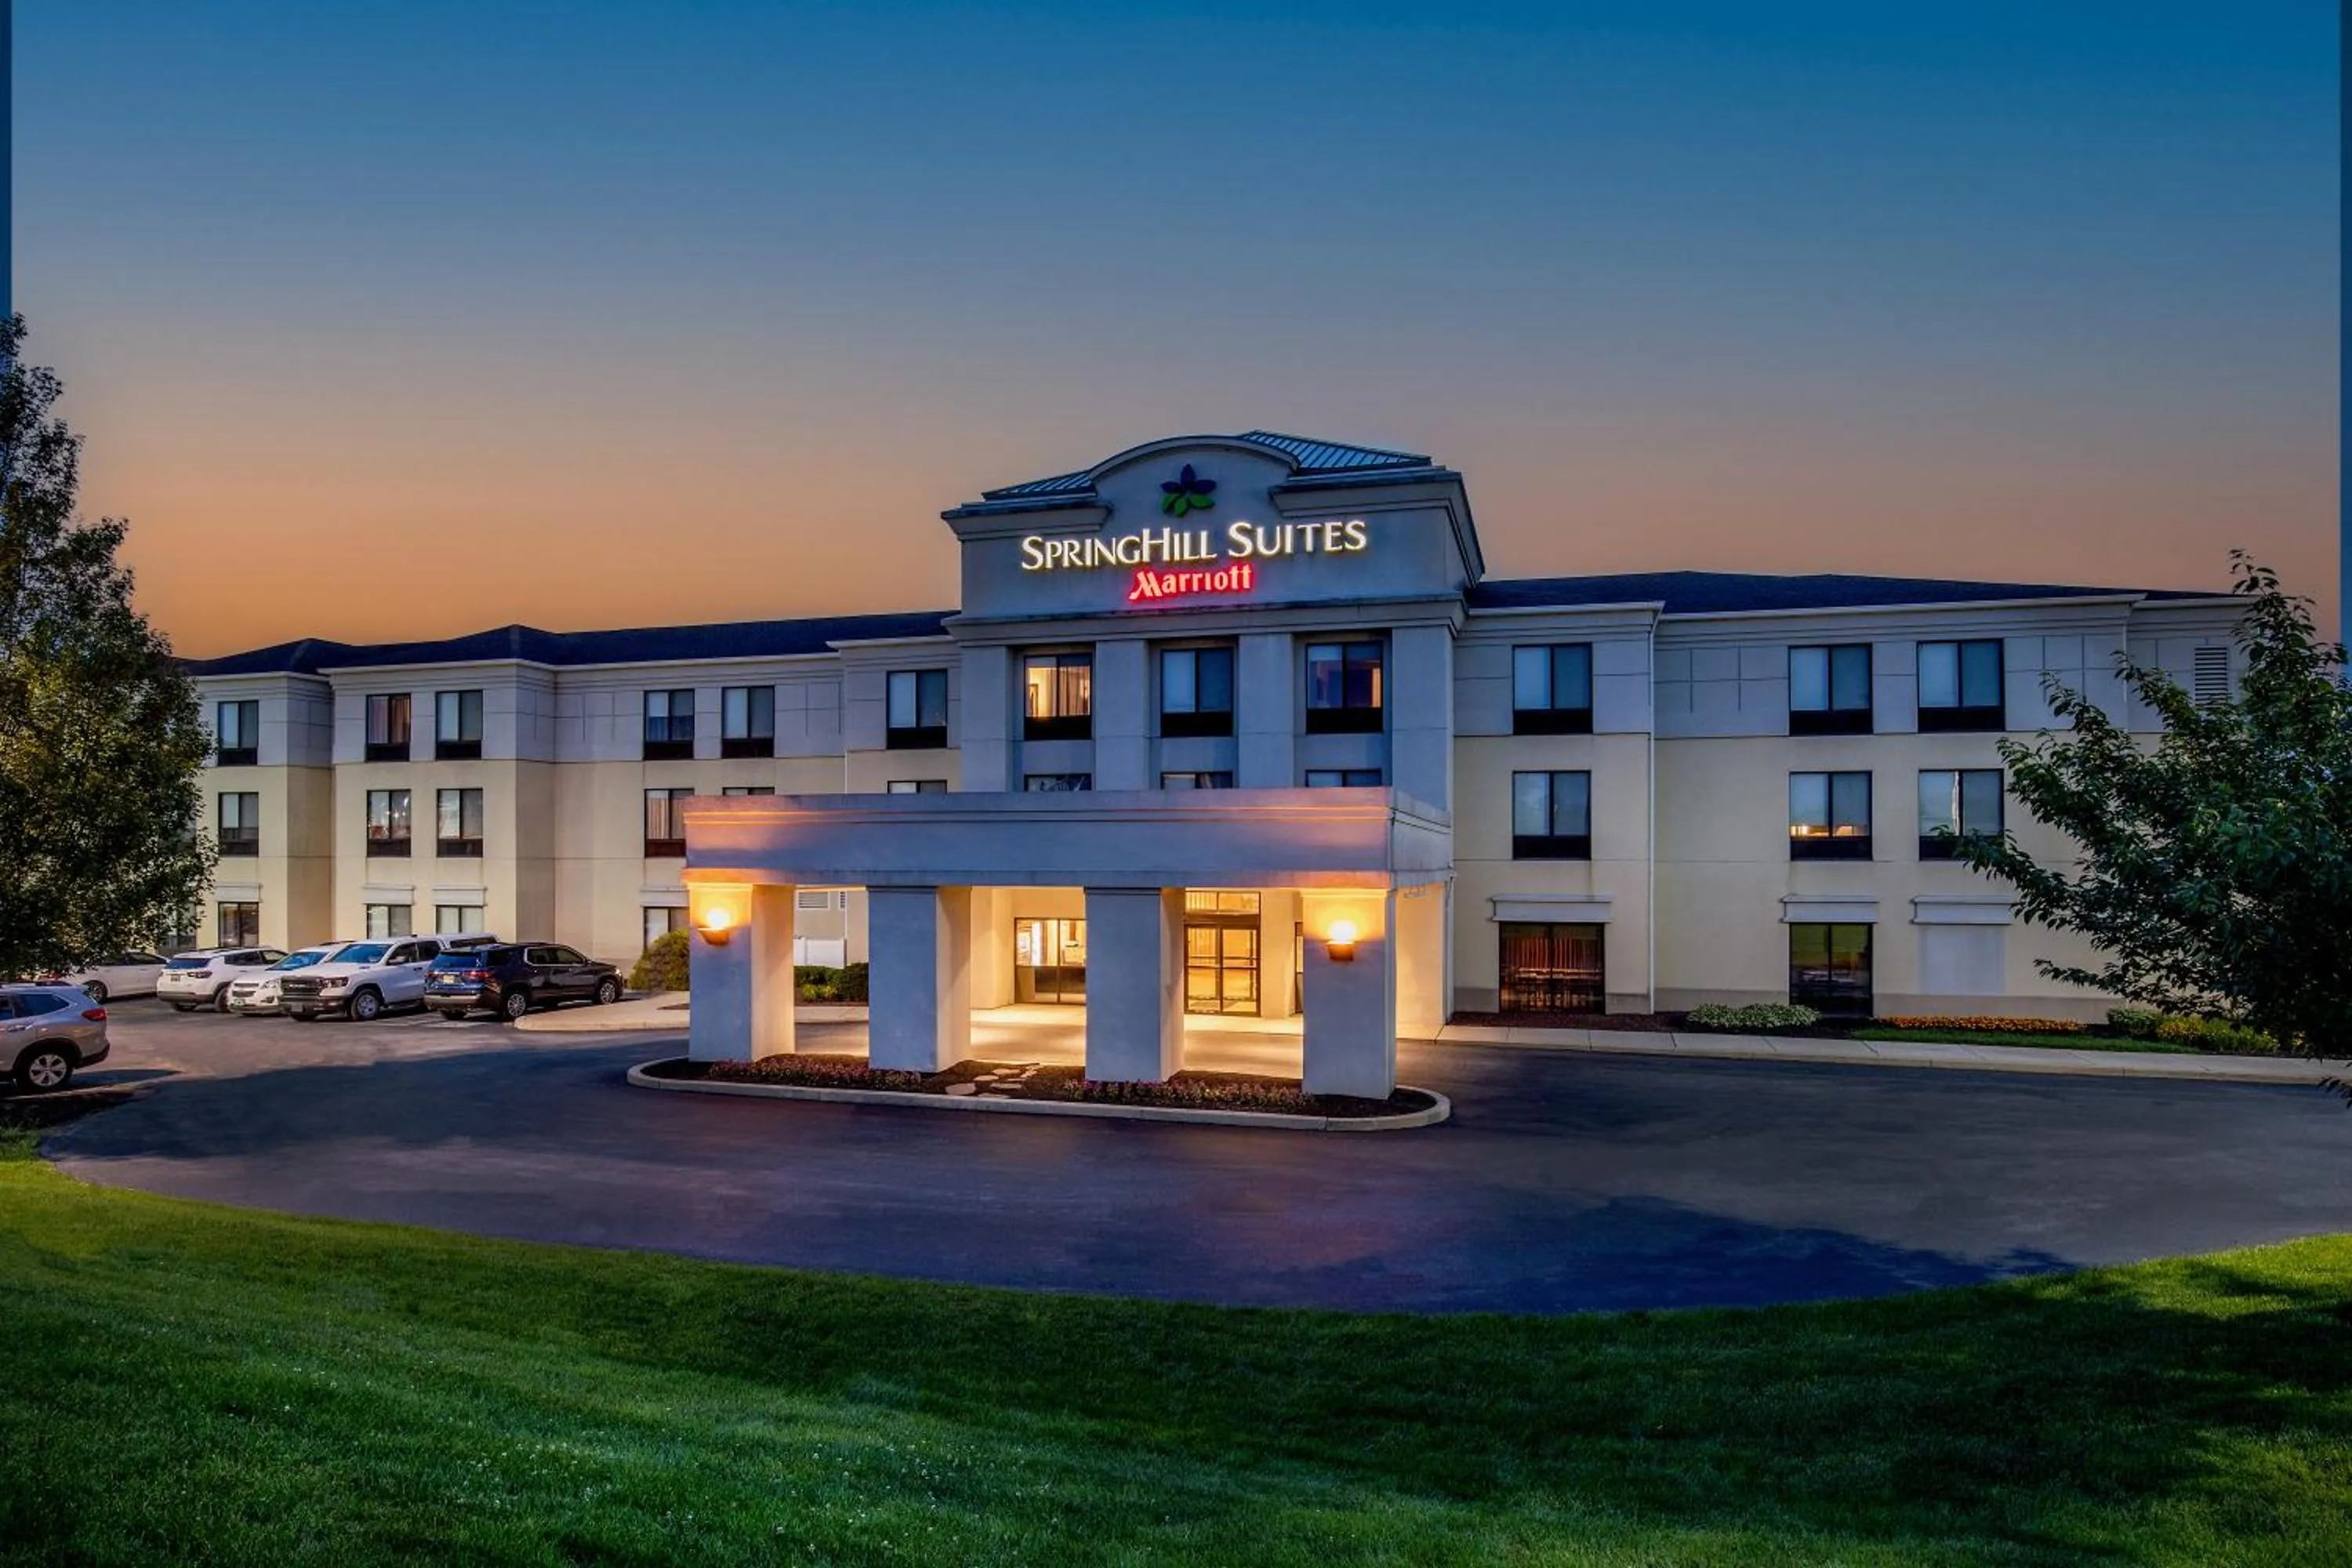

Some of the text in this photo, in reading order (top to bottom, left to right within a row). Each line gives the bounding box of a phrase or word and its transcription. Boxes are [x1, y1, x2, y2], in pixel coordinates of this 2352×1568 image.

[1021, 520, 1368, 571] SPRINGHILL SUITES
[1128, 564, 1253, 601] Marriott
